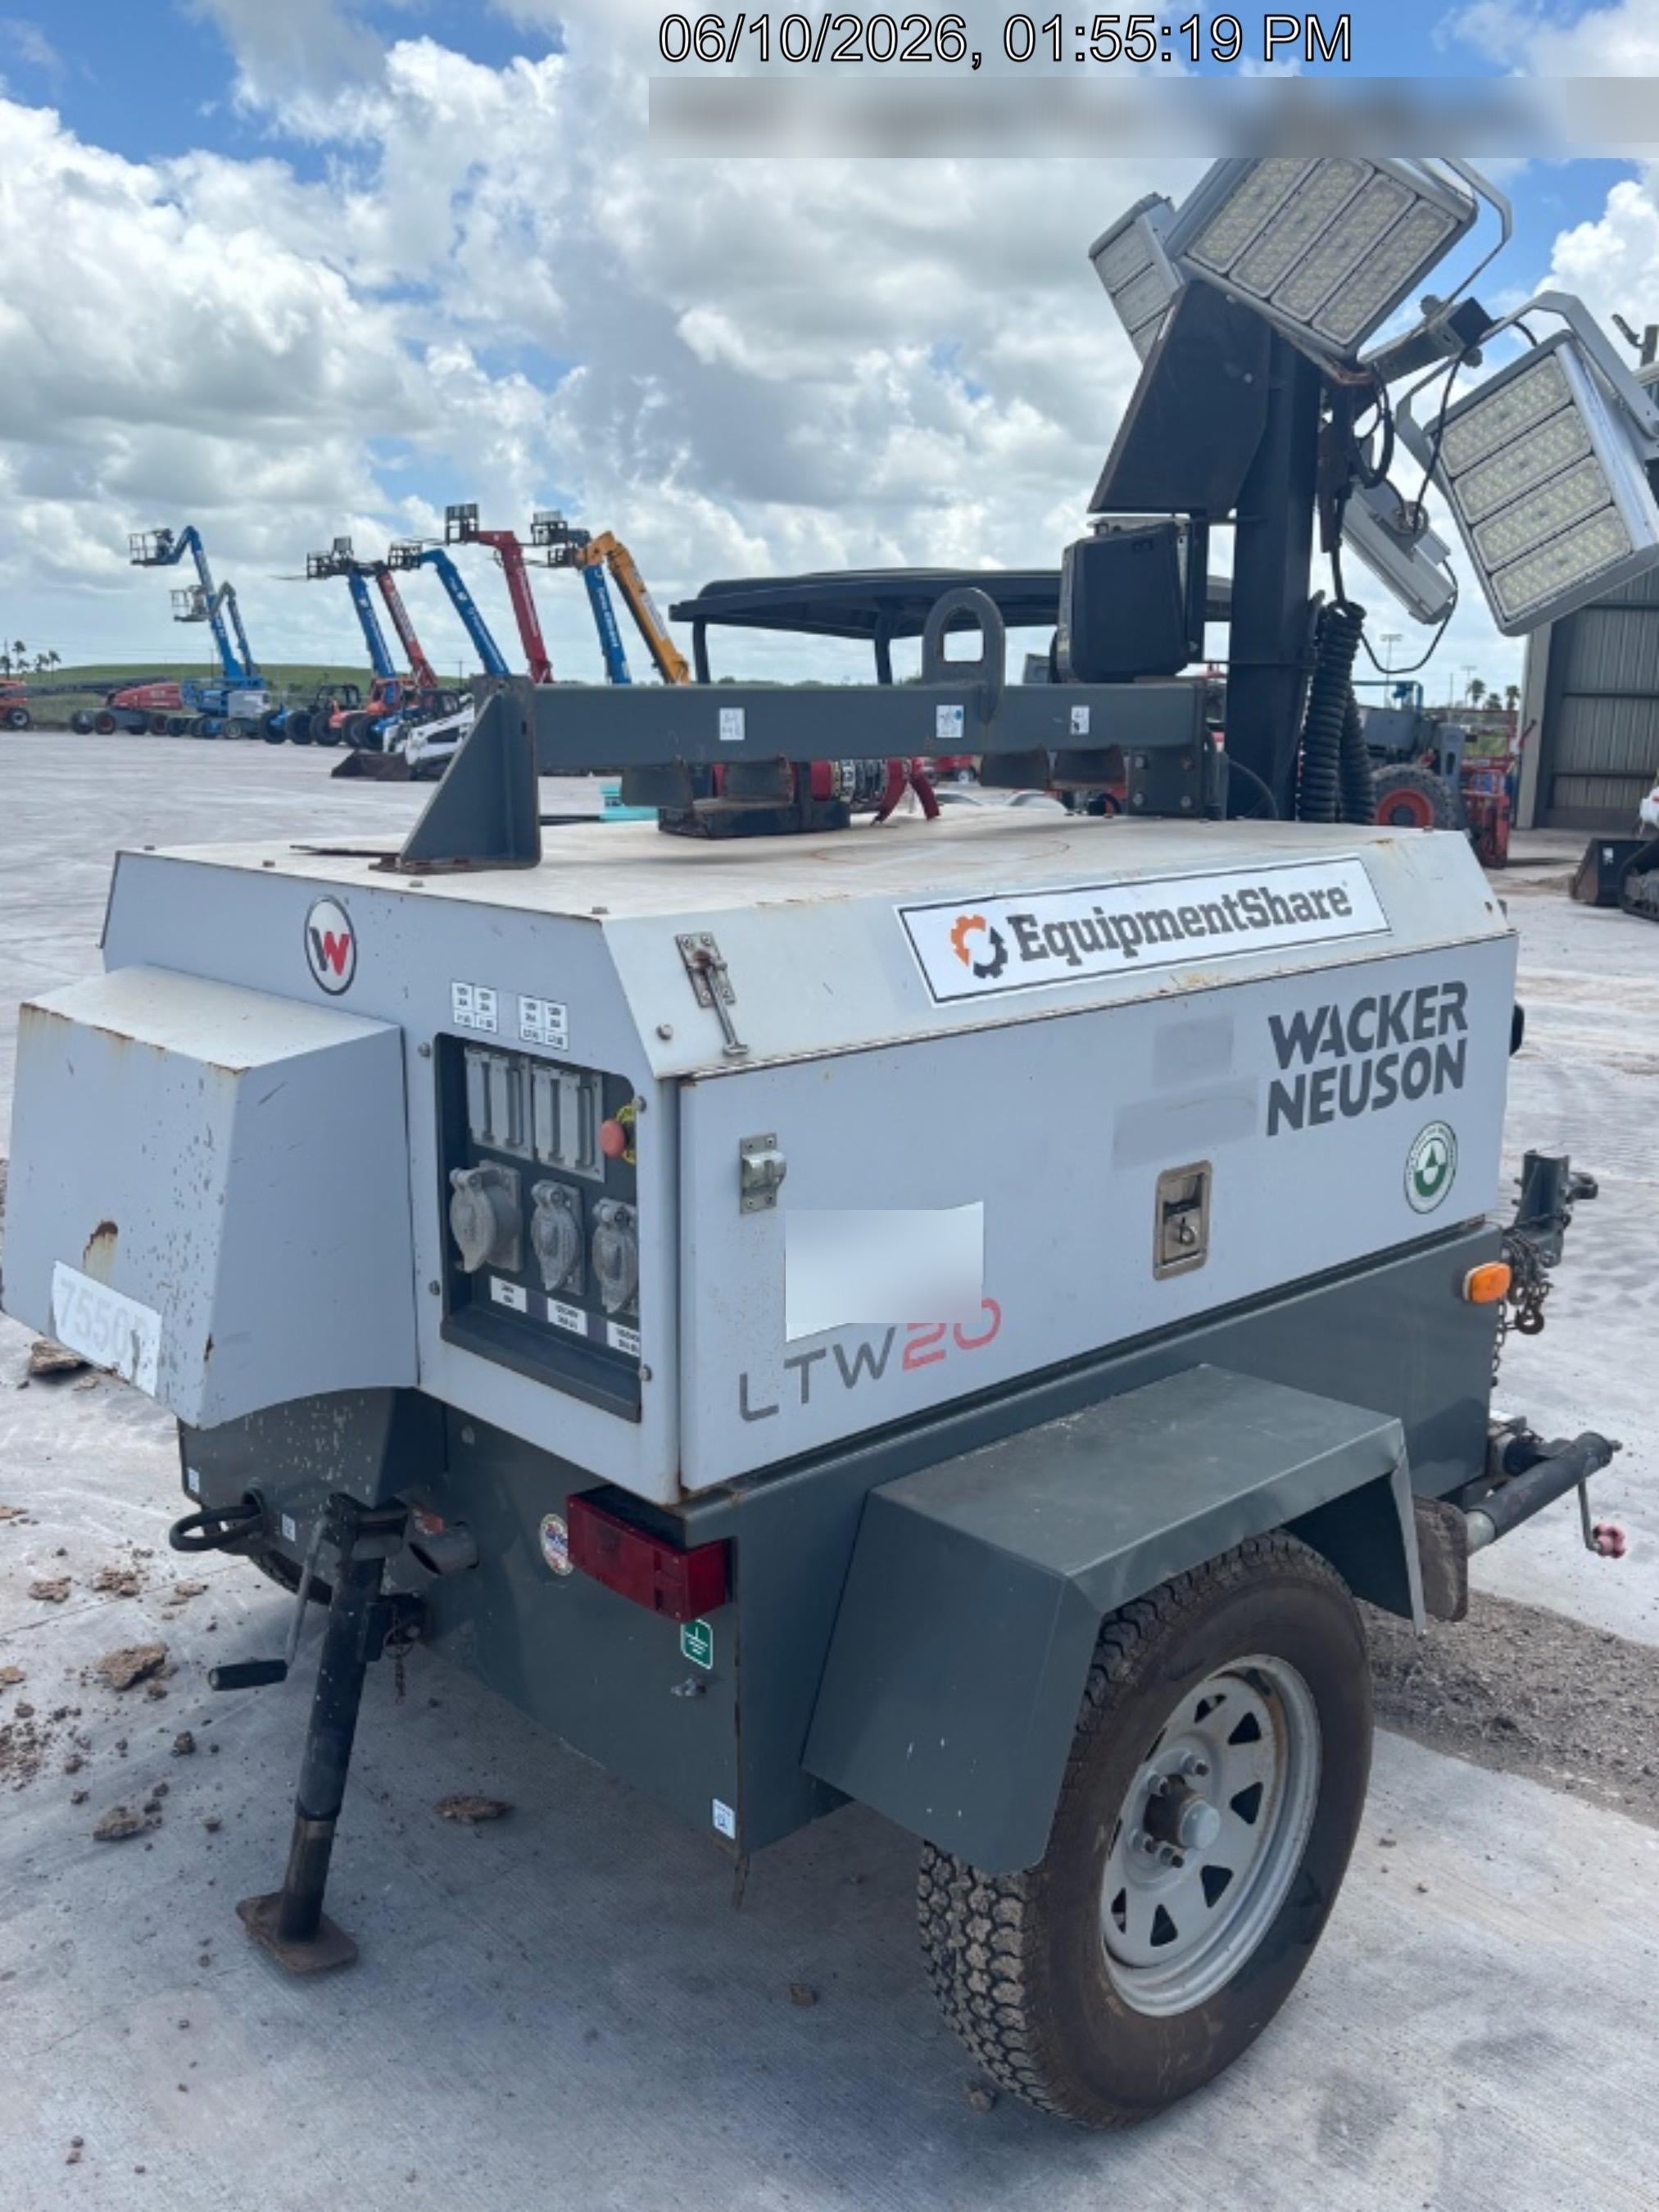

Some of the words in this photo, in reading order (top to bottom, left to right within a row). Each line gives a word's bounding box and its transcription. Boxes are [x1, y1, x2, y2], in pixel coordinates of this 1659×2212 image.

[1007, 885, 1353, 967] EquipmentShare
[1267, 981, 1468, 1070] WACKER
[1266, 1037, 1468, 1136] NEUSON
